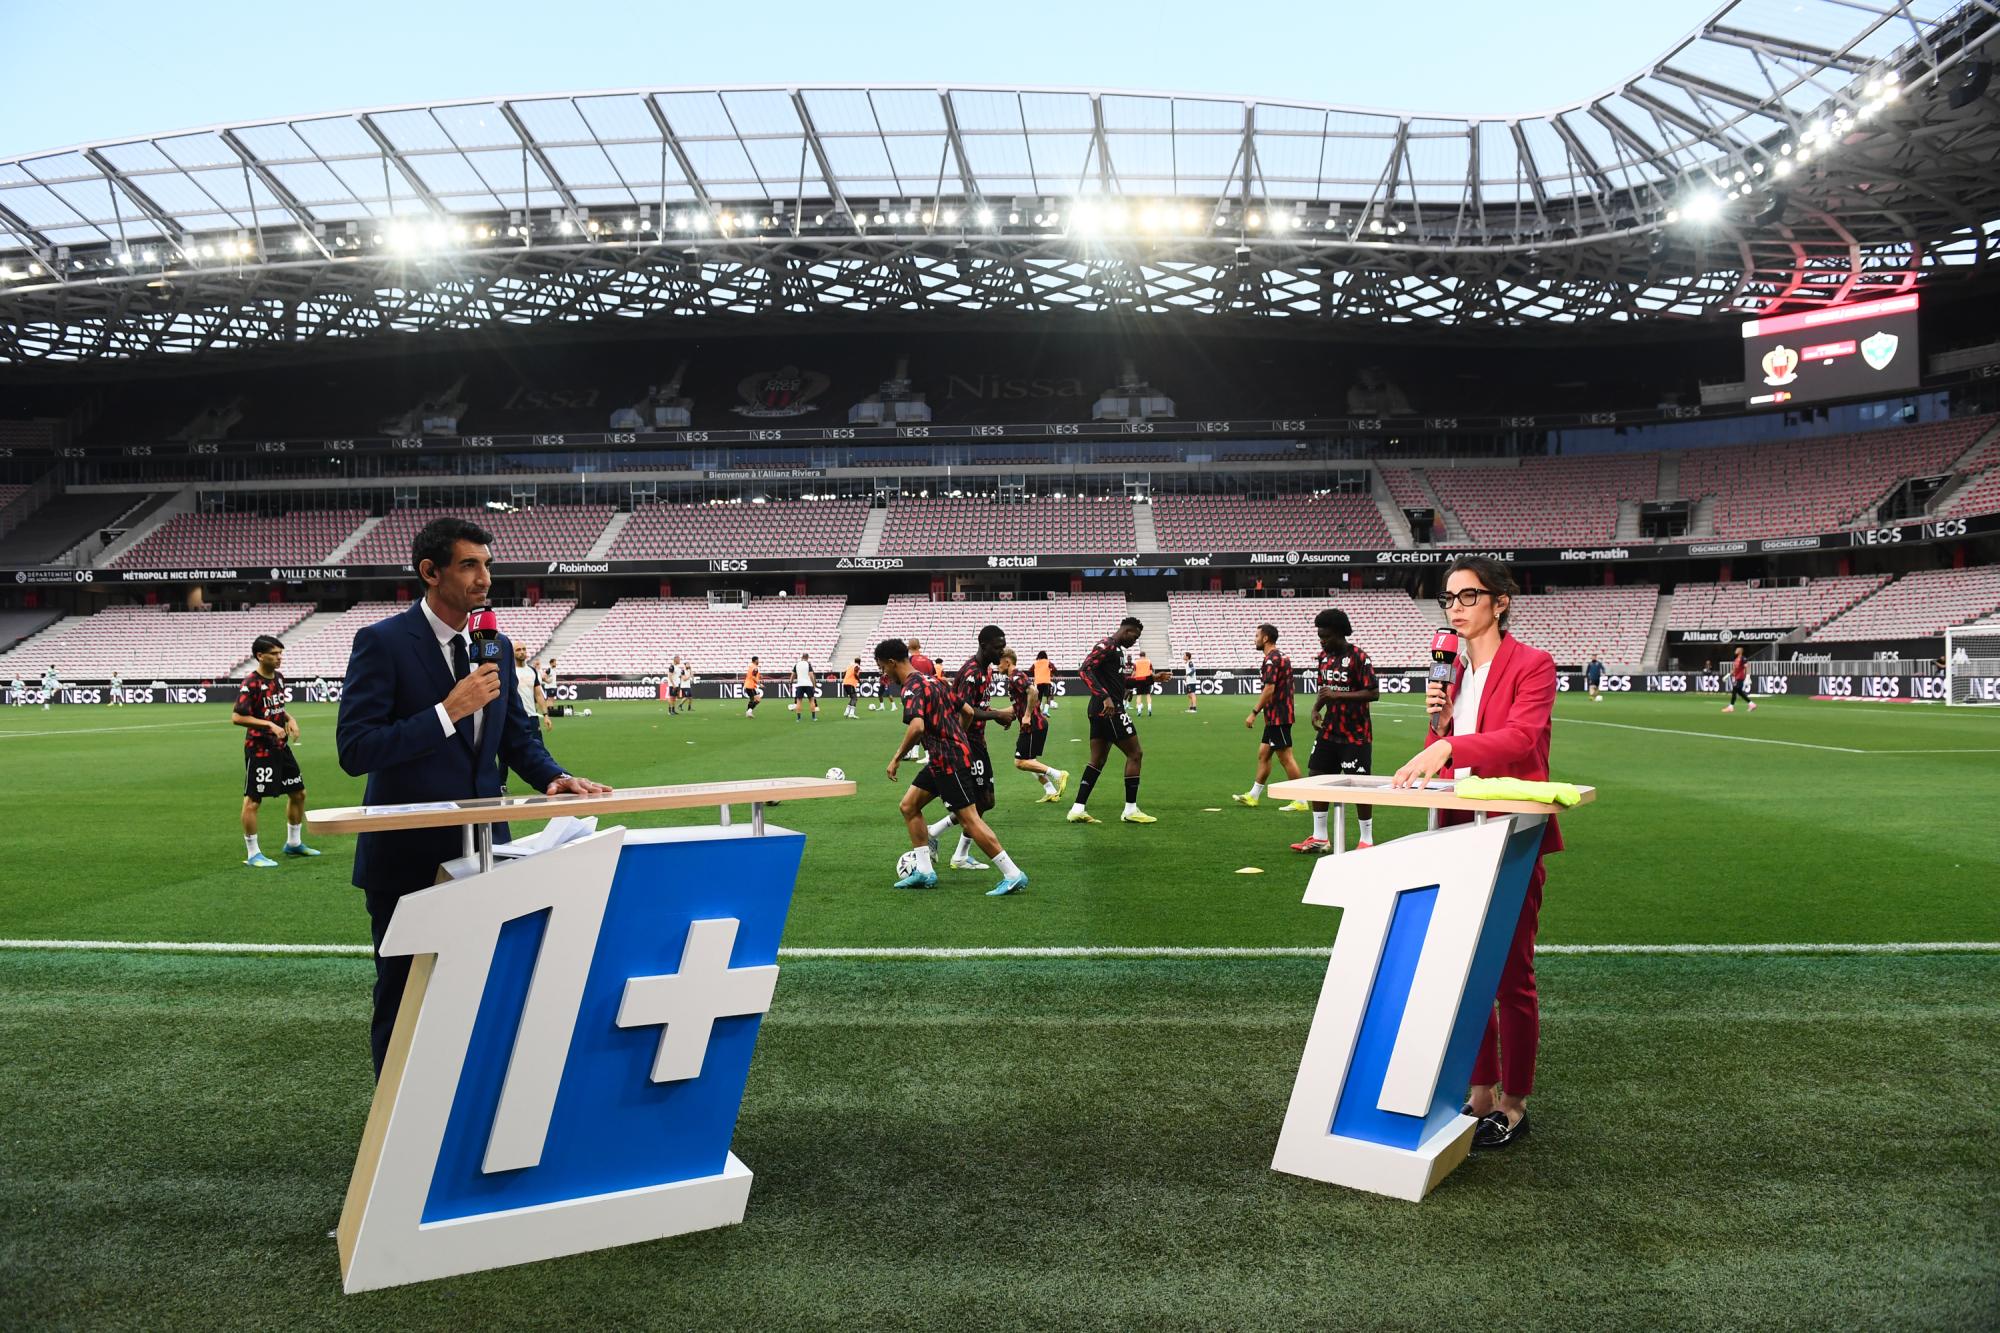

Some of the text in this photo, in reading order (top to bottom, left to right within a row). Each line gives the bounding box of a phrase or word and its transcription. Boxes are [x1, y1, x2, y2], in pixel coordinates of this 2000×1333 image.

[945, 373, 1085, 401] Nissa
[1664, 406, 1700, 418] INEOS
[1425, 418, 1458, 429] INEOS
[1501, 416, 1535, 428] INEOS
[1581, 412, 1616, 424] INEOS
[1046, 424, 1079, 434] INEOS
[1121, 423, 1154, 433] INEOS
[1197, 422, 1230, 432] INEOS
[1272, 420, 1305, 431] INEOS
[1349, 419, 1381, 430] INEOS
[676, 431, 708, 441] INEOS
[750, 430, 781, 440] INEOS
[823, 428, 855, 439] INEOS
[897, 427, 929, 437] INEOS
[972, 426, 1004, 436] INEOS
[392, 438, 423, 448] INEOS
[462, 436, 493, 447] INEOS
[533, 435, 564, 445] INEOS
[605, 433, 636, 443] INEOS
[189, 443, 218, 454] INEOS
[256, 442, 286, 451] INEOS
[324, 440, 354, 450] INEOS
[55, 448, 85, 457] INEOS
[123, 446, 152, 456] INEOS
[709, 471, 749, 479] Bienvenue
[792, 469, 820, 477] Riviera
[1922, 519, 1967, 539] INEOS
[1851, 528, 1902, 546] INEOS
[1764, 540, 1817, 548] OGCNICE.COM
[1250, 553, 1350, 563] Allianz Assurance
[1392, 552, 1441, 563] CRÉDIT
[1560, 549, 1628, 560] nice-matin
[709, 560, 747, 571] INEOS
[855, 558, 903, 568] Kappa
[999, 556, 1037, 567] actual
[1113, 556, 1138, 566] vbet
[1184, 555, 1209, 566] vbet
[281, 569, 347, 578] VILLE DE NICE
[559, 563, 608, 573] Robinhood
[76, 571, 93, 582] 06
[123, 571, 168, 580] MÉTROPOLE
[189, 569, 208, 579] CÔTE
[210, 571, 237, 579] D'AZUR
[1682, 631, 1786, 641] Allianz Assuranc
[1584, 676, 1631, 692] IEOS
[1647, 676, 1686, 691] INEOS
[1696, 676, 1719, 691] INEOS
[1759, 676, 1787, 693] INEOS
[1819, 676, 1851, 695] INEOS
[1862, 677, 1899, 697] INEOS
[61, 688, 101, 703] INEOS
[166, 688, 206, 703] INEOS
[606, 686, 656, 699] BARRAGES
[256, 767, 273, 782] 32
[282, 776, 302, 786] vbet
